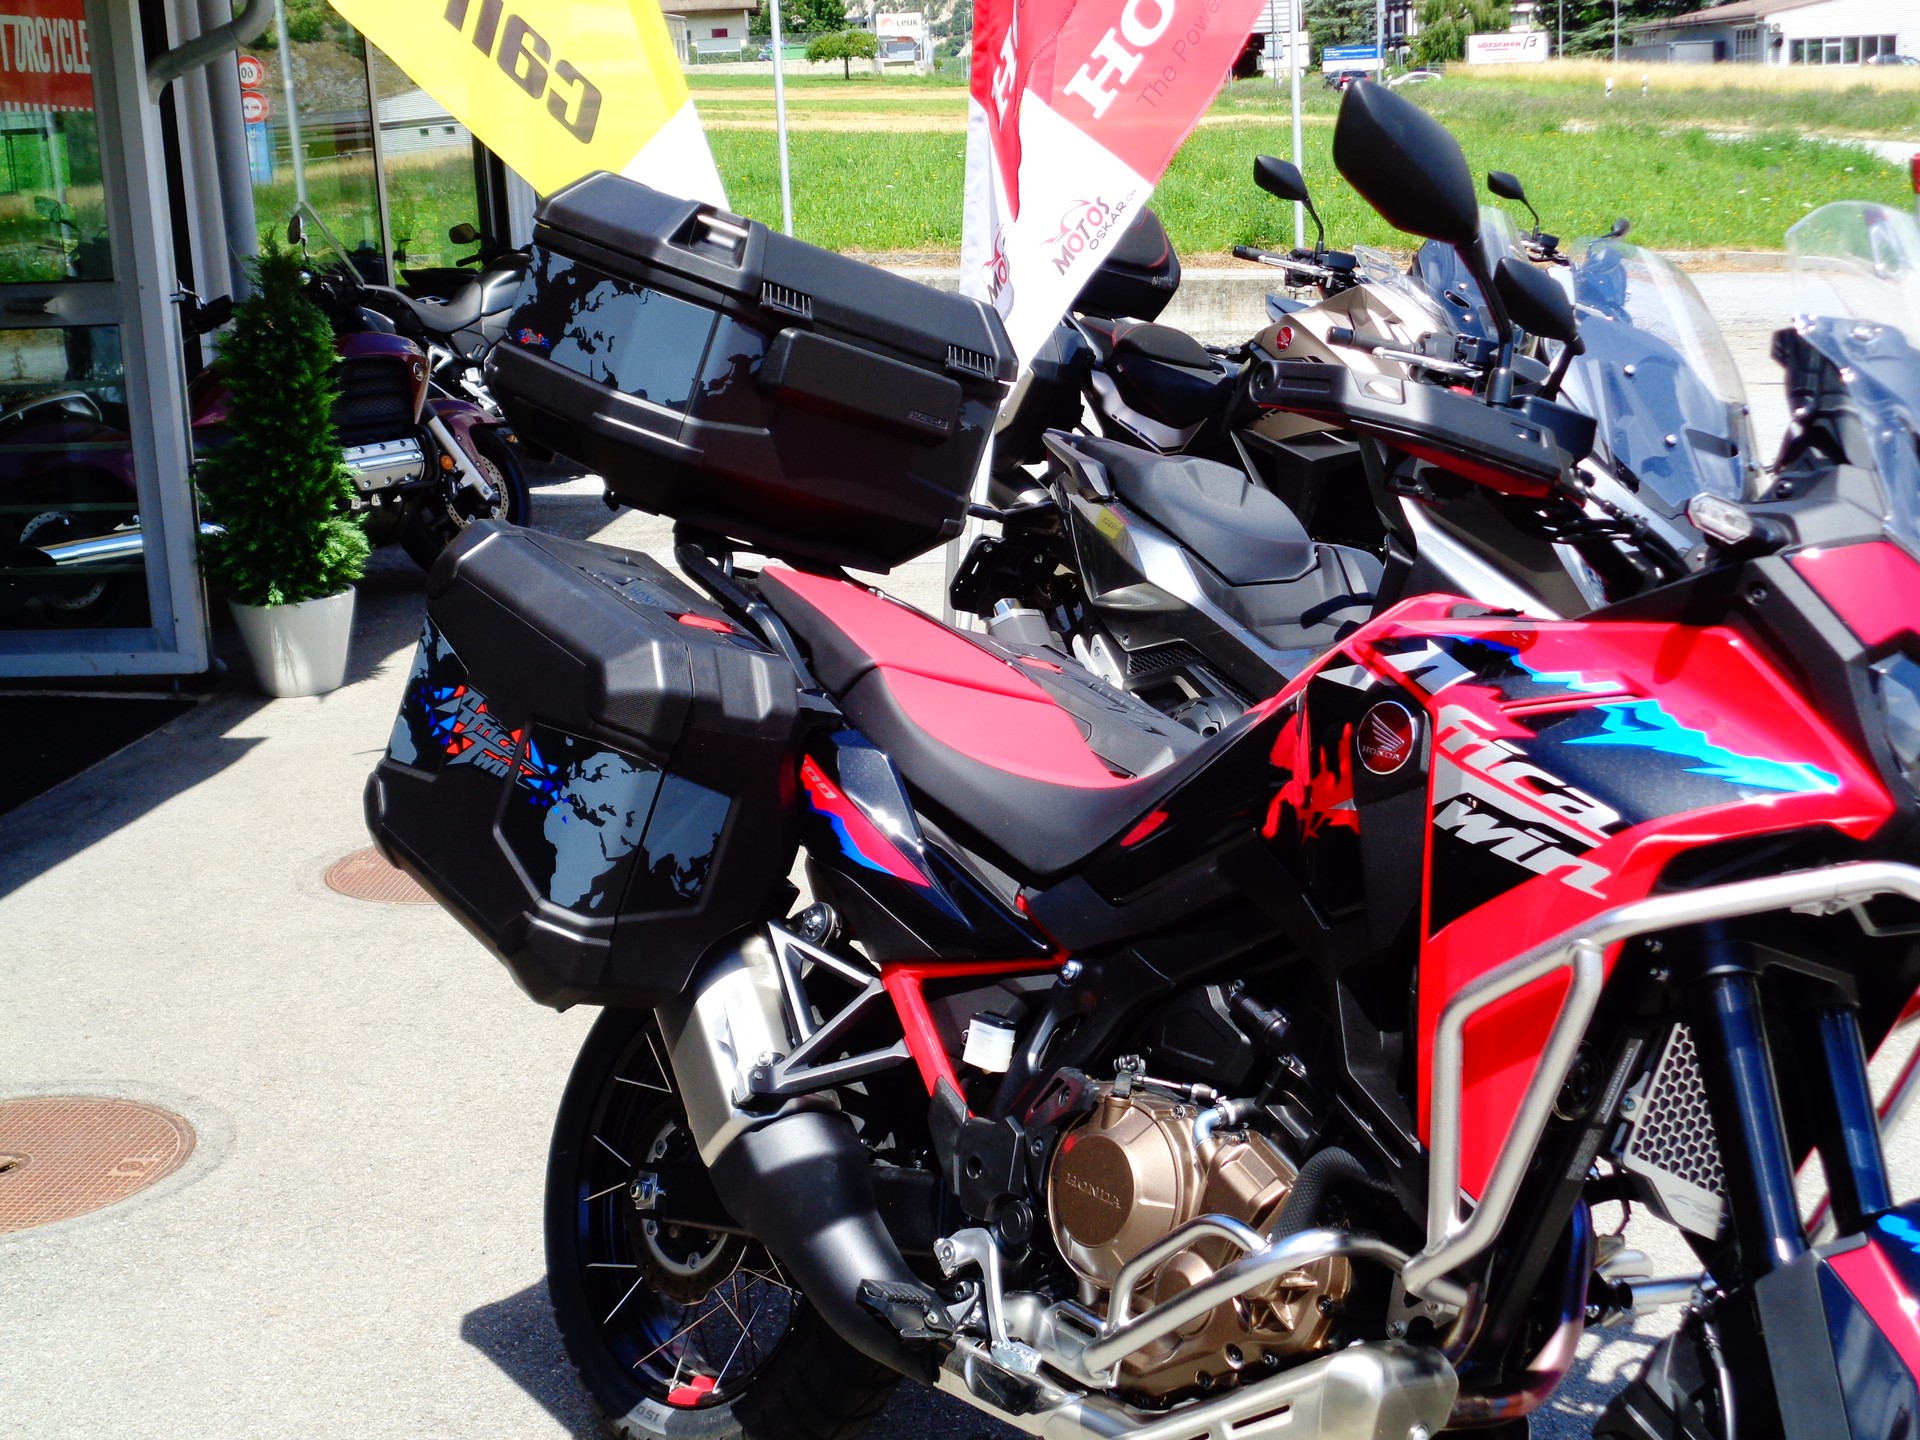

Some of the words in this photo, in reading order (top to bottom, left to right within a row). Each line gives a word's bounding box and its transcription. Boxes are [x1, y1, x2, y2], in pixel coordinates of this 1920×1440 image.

[1136, 65, 1177, 108] The
[1172, 0, 1223, 63] Powe
[1052, 196, 1110, 276] MOTOS
[1362, 745, 1401, 762] HONDA
[1065, 1172, 1122, 1209] HONDA
